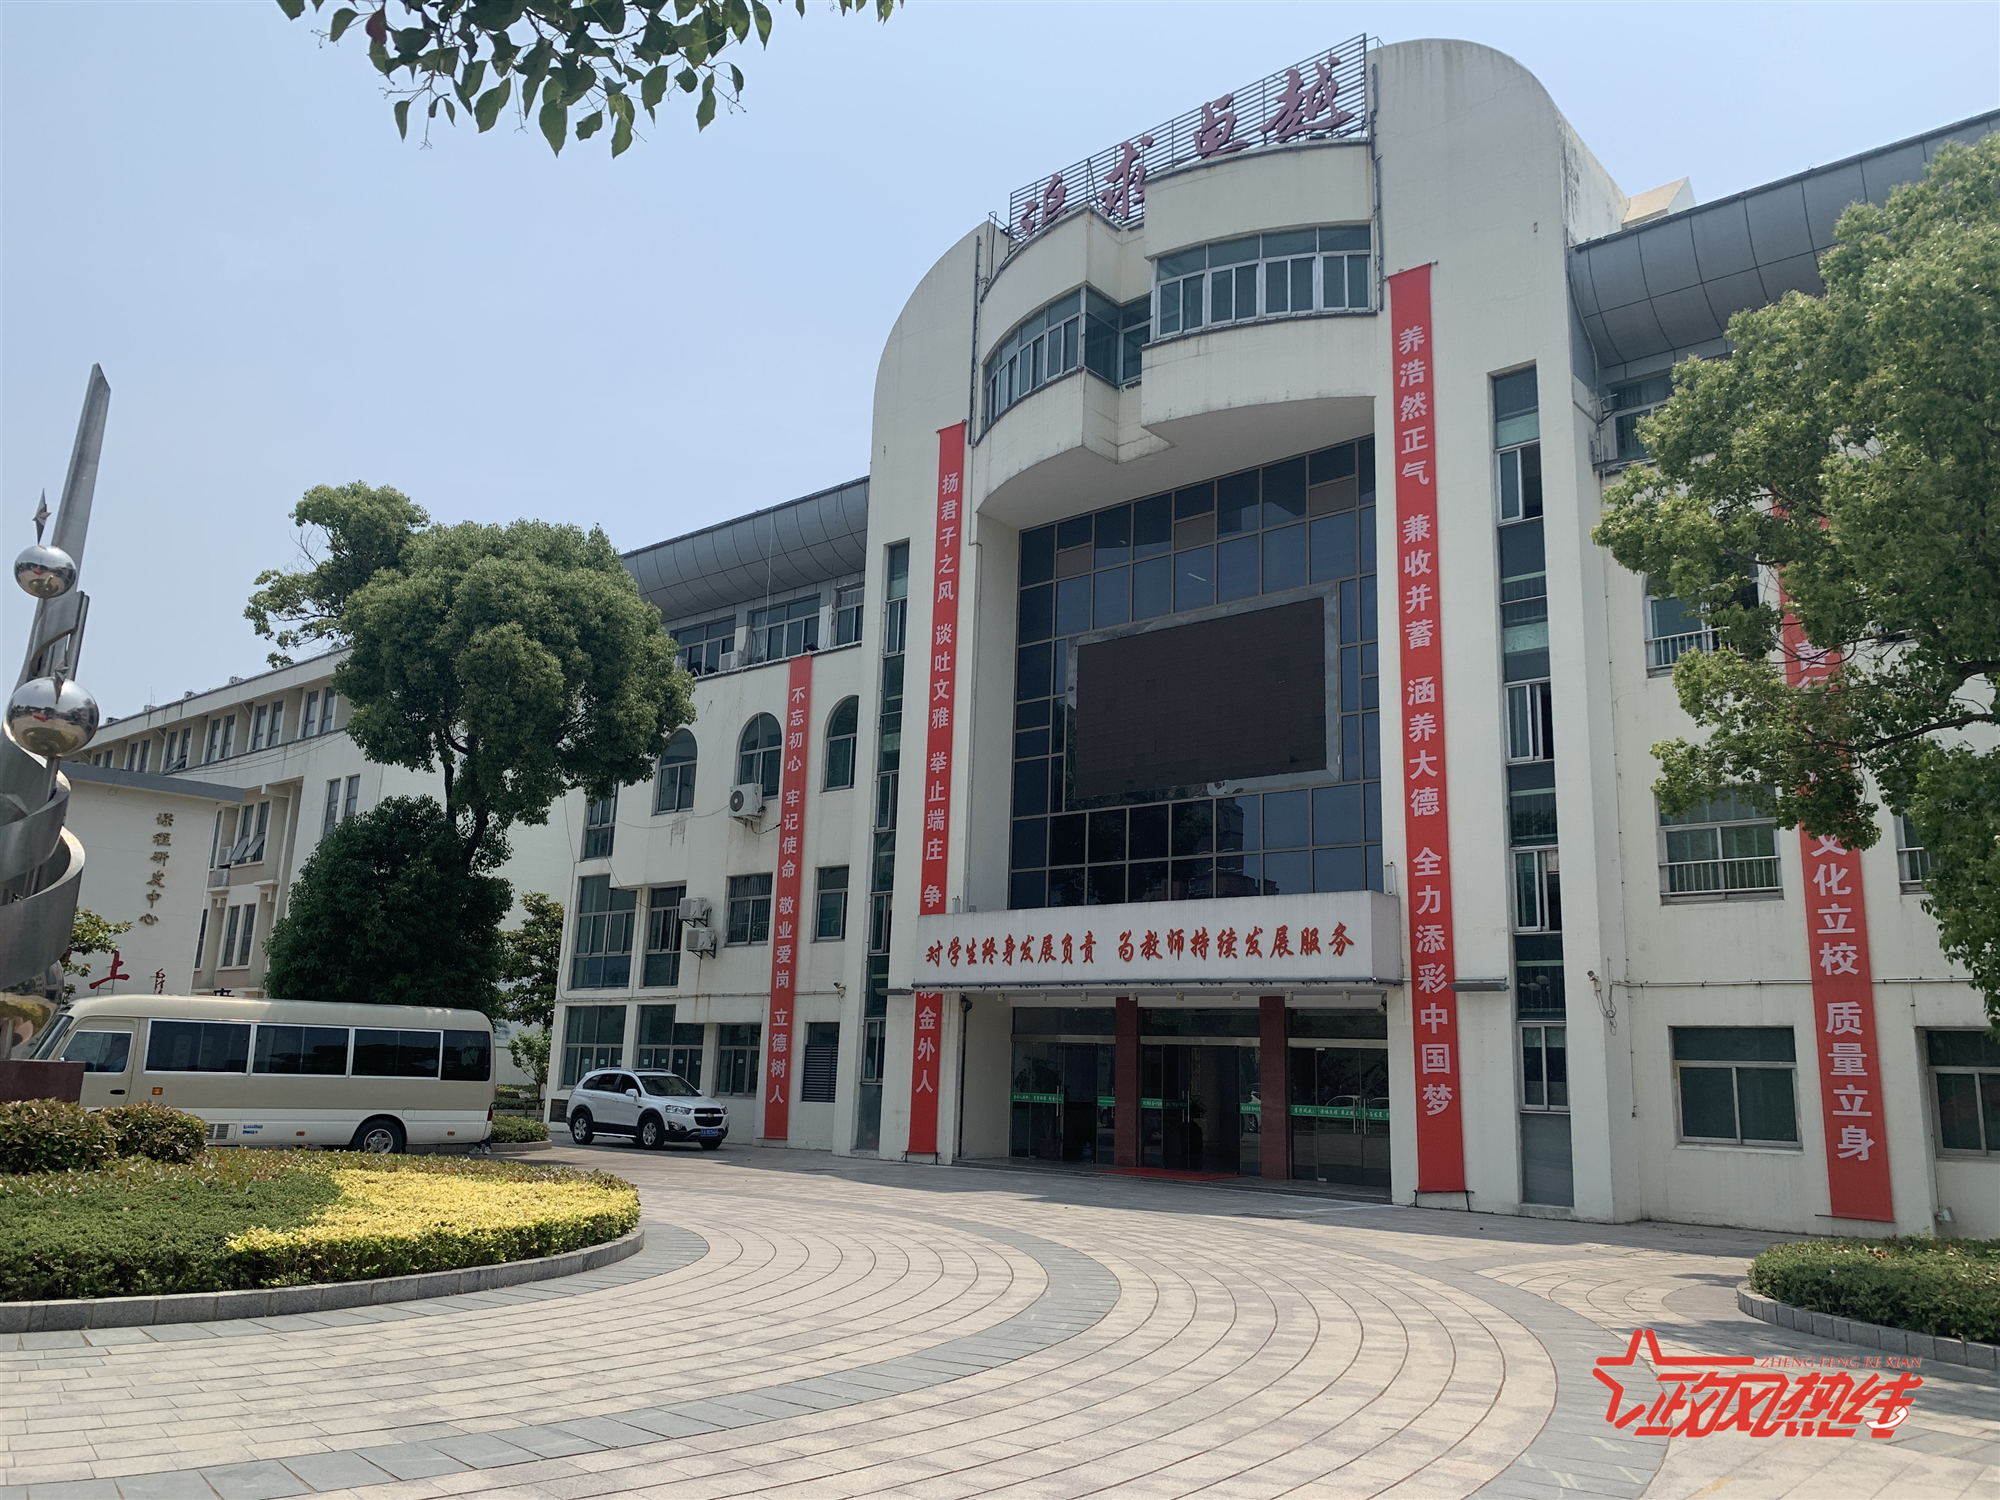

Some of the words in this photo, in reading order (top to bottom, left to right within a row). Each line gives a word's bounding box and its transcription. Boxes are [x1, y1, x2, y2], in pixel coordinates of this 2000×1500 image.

[1020, 57, 1355, 236] 追求卓越
[1398, 324, 1430, 486] 养浩然正气
[936, 472, 959, 603] 扬君子之风
[1402, 513, 1434, 650] 兼收并蓄
[786, 685, 806, 772] 不忘初心
[931, 623, 953, 730] 谈吐文雅
[925, 751, 947, 861] 举止端庄
[1407, 676, 1441, 817] 涵养大德
[780, 788, 800, 879] 牢记使命
[775, 896, 795, 990] 敬业爱岗
[925, 929, 1097, 968] 对学生终身发展负责
[1117, 921, 1355, 963] 为教师持续发展服务
[1810, 834, 1860, 977] 文化立校
[1412, 845, 1453, 1117] 全力添彩中国梦
[769, 1007, 789, 1104] 立德树人
[915, 992, 937, 1094] 金外人
[1825, 1001, 1875, 1162] 质量立身
